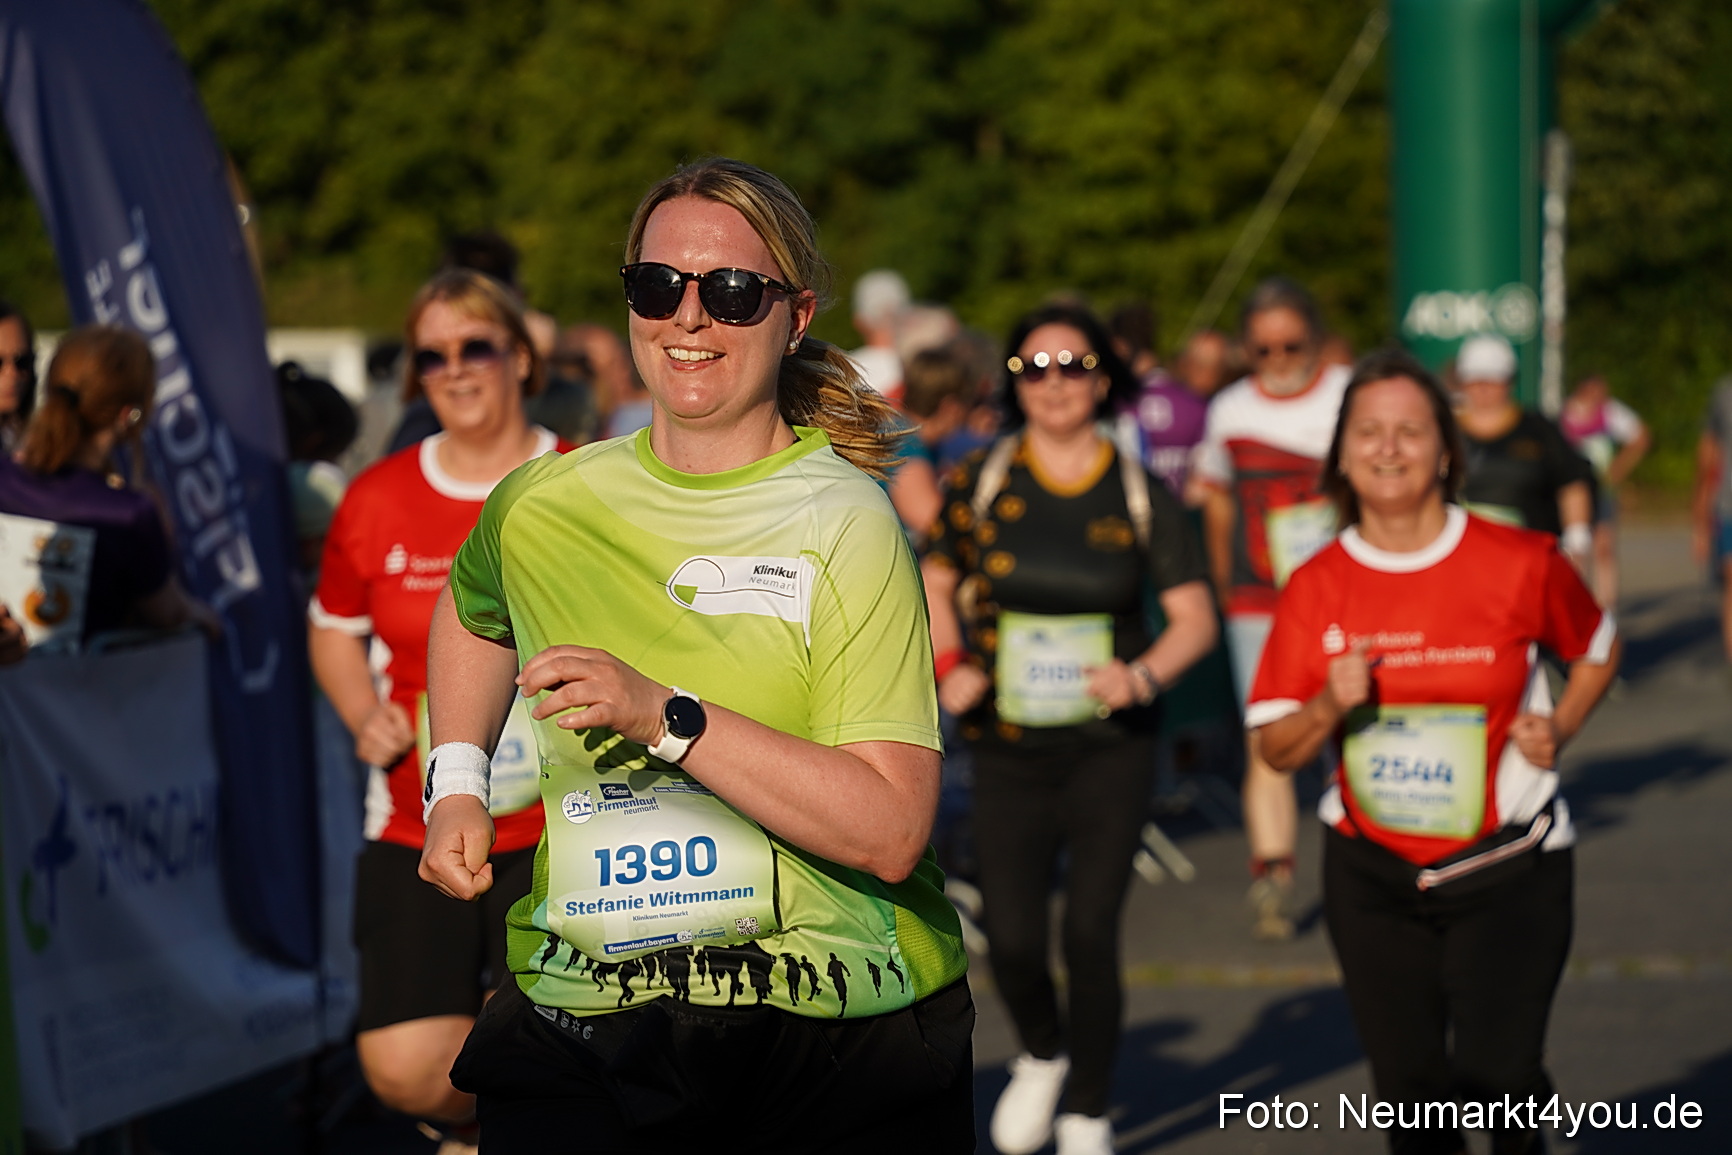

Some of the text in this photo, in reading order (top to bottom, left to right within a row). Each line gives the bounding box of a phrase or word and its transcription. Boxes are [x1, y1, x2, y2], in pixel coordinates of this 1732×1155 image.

[1370, 756, 1453, 785] 2544
[597, 796, 658, 813] Firmenlauf
[623, 805, 660, 816] neumarkt
[594, 835, 718, 887] 1390
[565, 886, 754, 917] Stefanie Witmmann
[632, 910, 689, 922] Klinikum Neumarkt
[607, 937, 675, 954] firmenlauf.bayern
